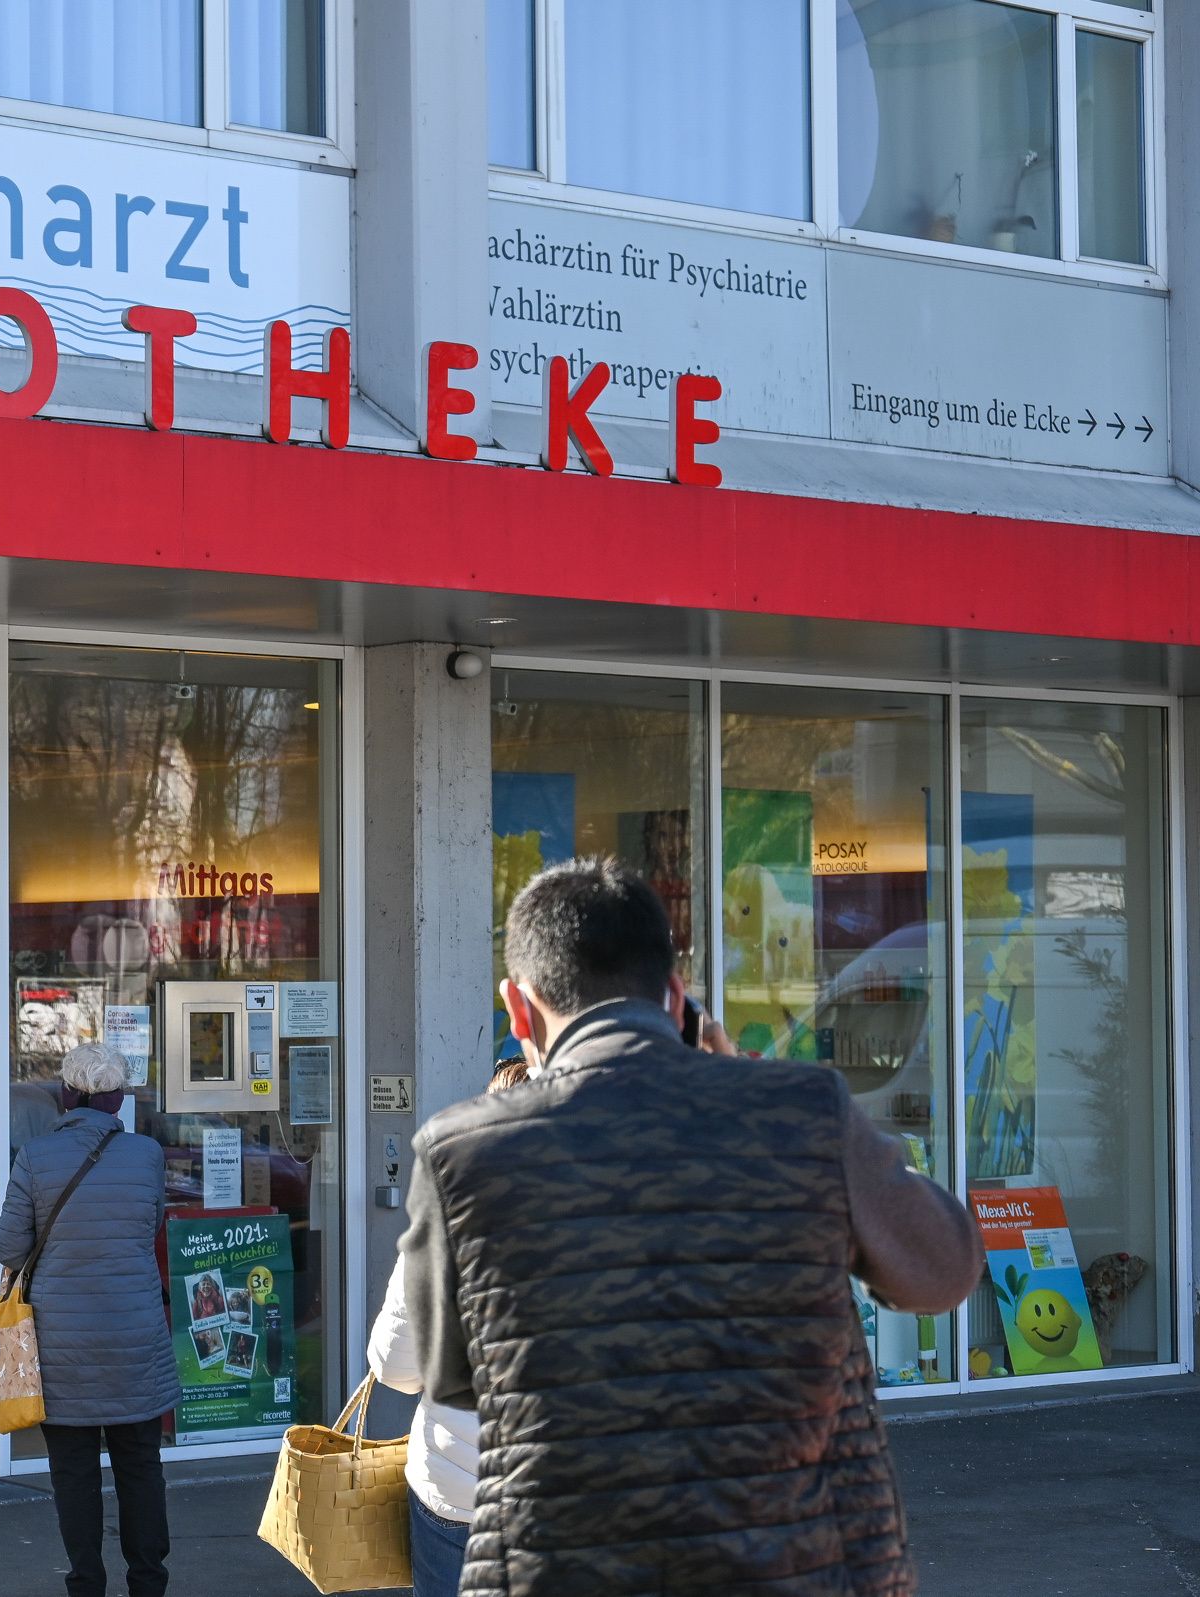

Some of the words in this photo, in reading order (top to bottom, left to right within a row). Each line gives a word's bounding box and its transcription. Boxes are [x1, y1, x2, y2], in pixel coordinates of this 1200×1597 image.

[621, 243, 660, 281] für
[668, 251, 808, 301] Psychiatrie
[851, 383, 940, 429] Eingang
[946, 402, 980, 424] um
[986, 398, 1018, 428] die
[1024, 403, 1071, 434] Ecke
[157, 862, 274, 908] Mittags
[253, 1083, 268, 1091] NAH
[976, 1202, 1023, 1219] Mexa-Vit
[1022, 1201, 1035, 1217] C.
[999, 1221, 1008, 1229] Tag
[180, 1242, 224, 1257] Vorsätze
[223, 1222, 269, 1249] 2021:
[188, 1233, 213, 1245] Meine
[194, 1254, 228, 1269] endlich
[229, 1241, 280, 1261] rauchfrei!
[263, 1410, 291, 1420] nicorette
